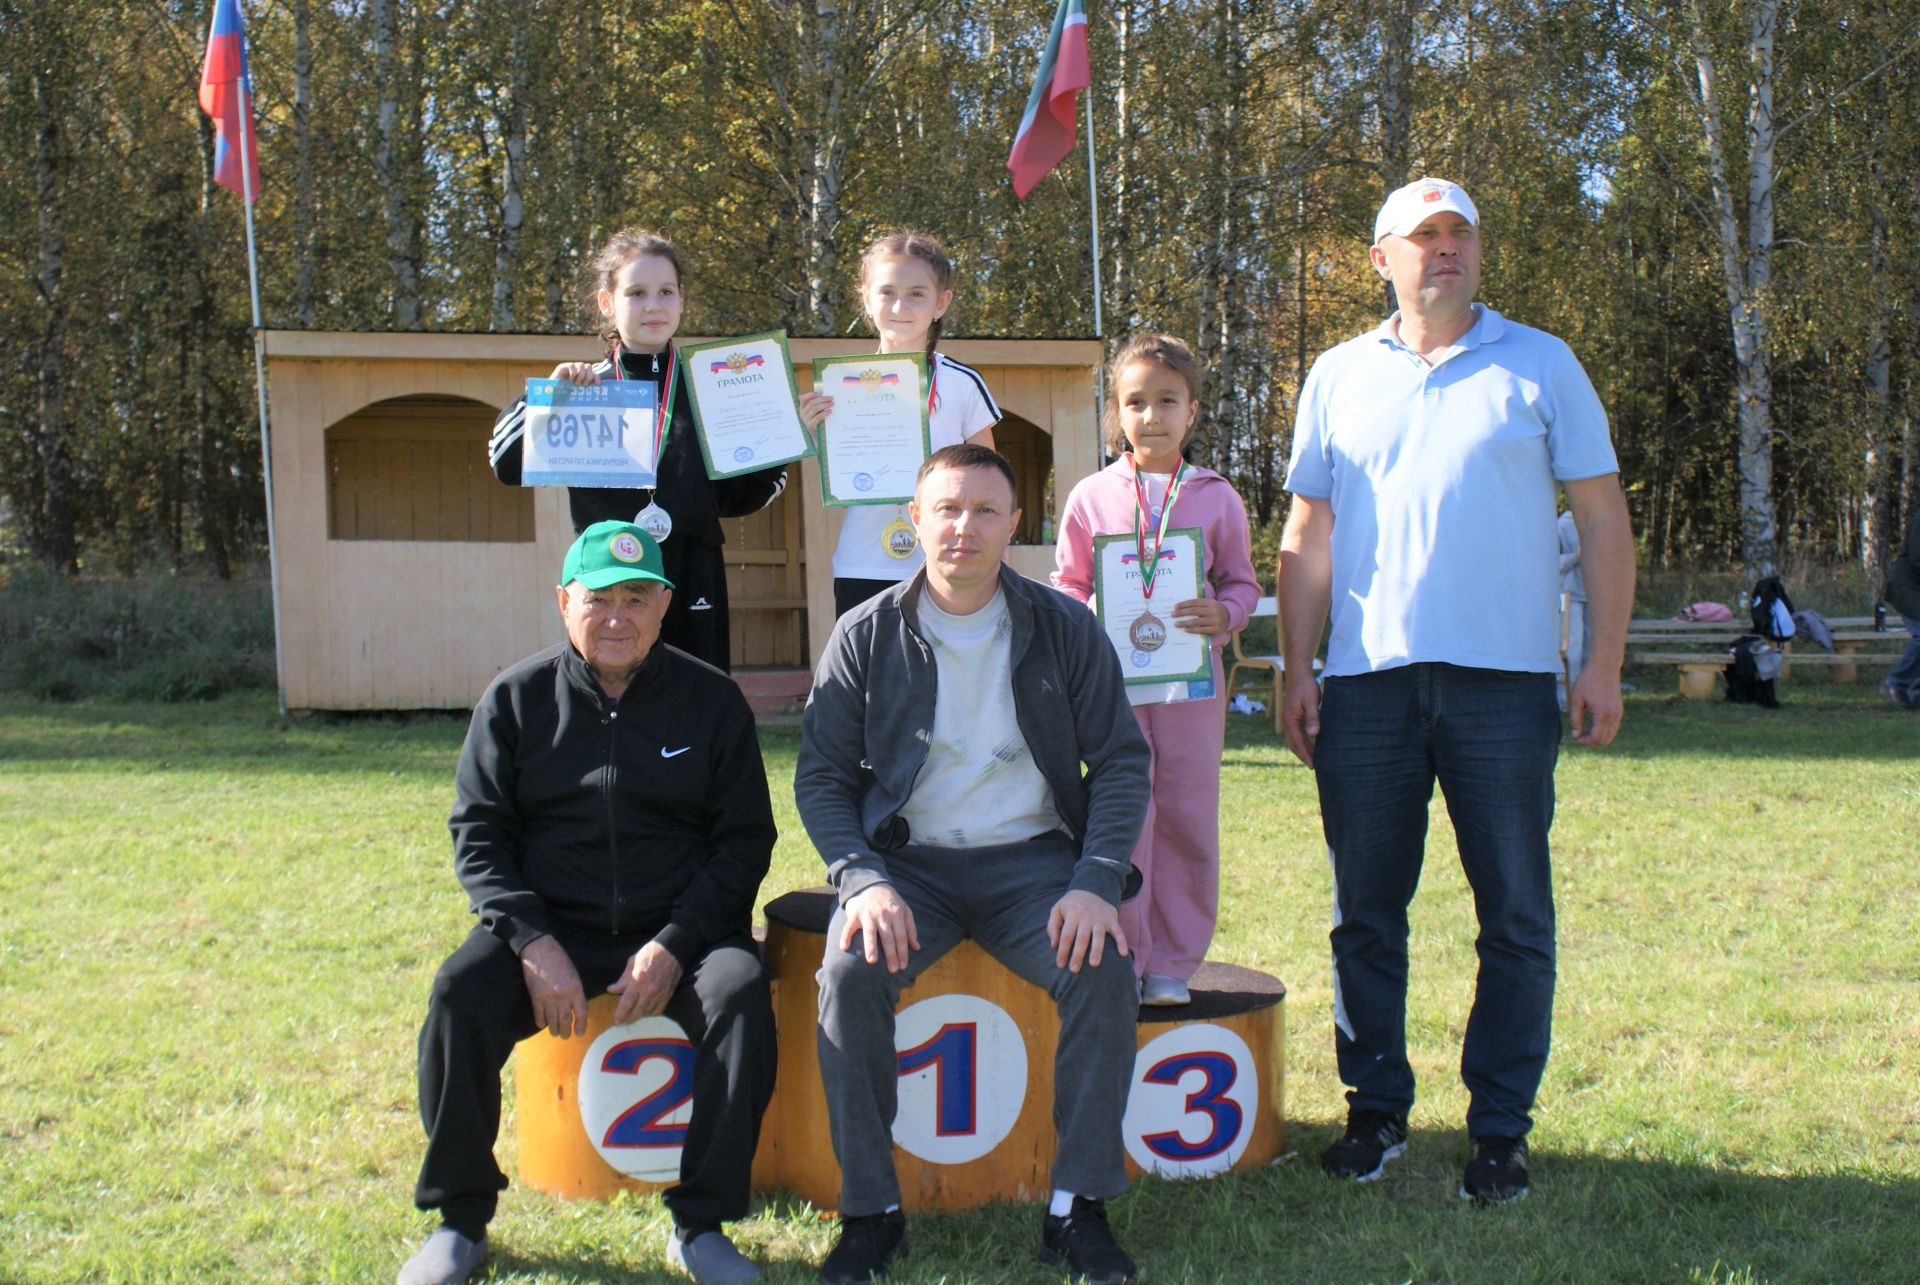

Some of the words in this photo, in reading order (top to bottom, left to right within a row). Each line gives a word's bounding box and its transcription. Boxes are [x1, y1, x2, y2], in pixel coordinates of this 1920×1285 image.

[717, 373, 764, 388] ГРАМОТА
[1125, 567, 1172, 580] ГРОТА
[601, 1037, 695, 1149] 2
[897, 1022, 977, 1137] 1
[1141, 1051, 1243, 1162] 3
